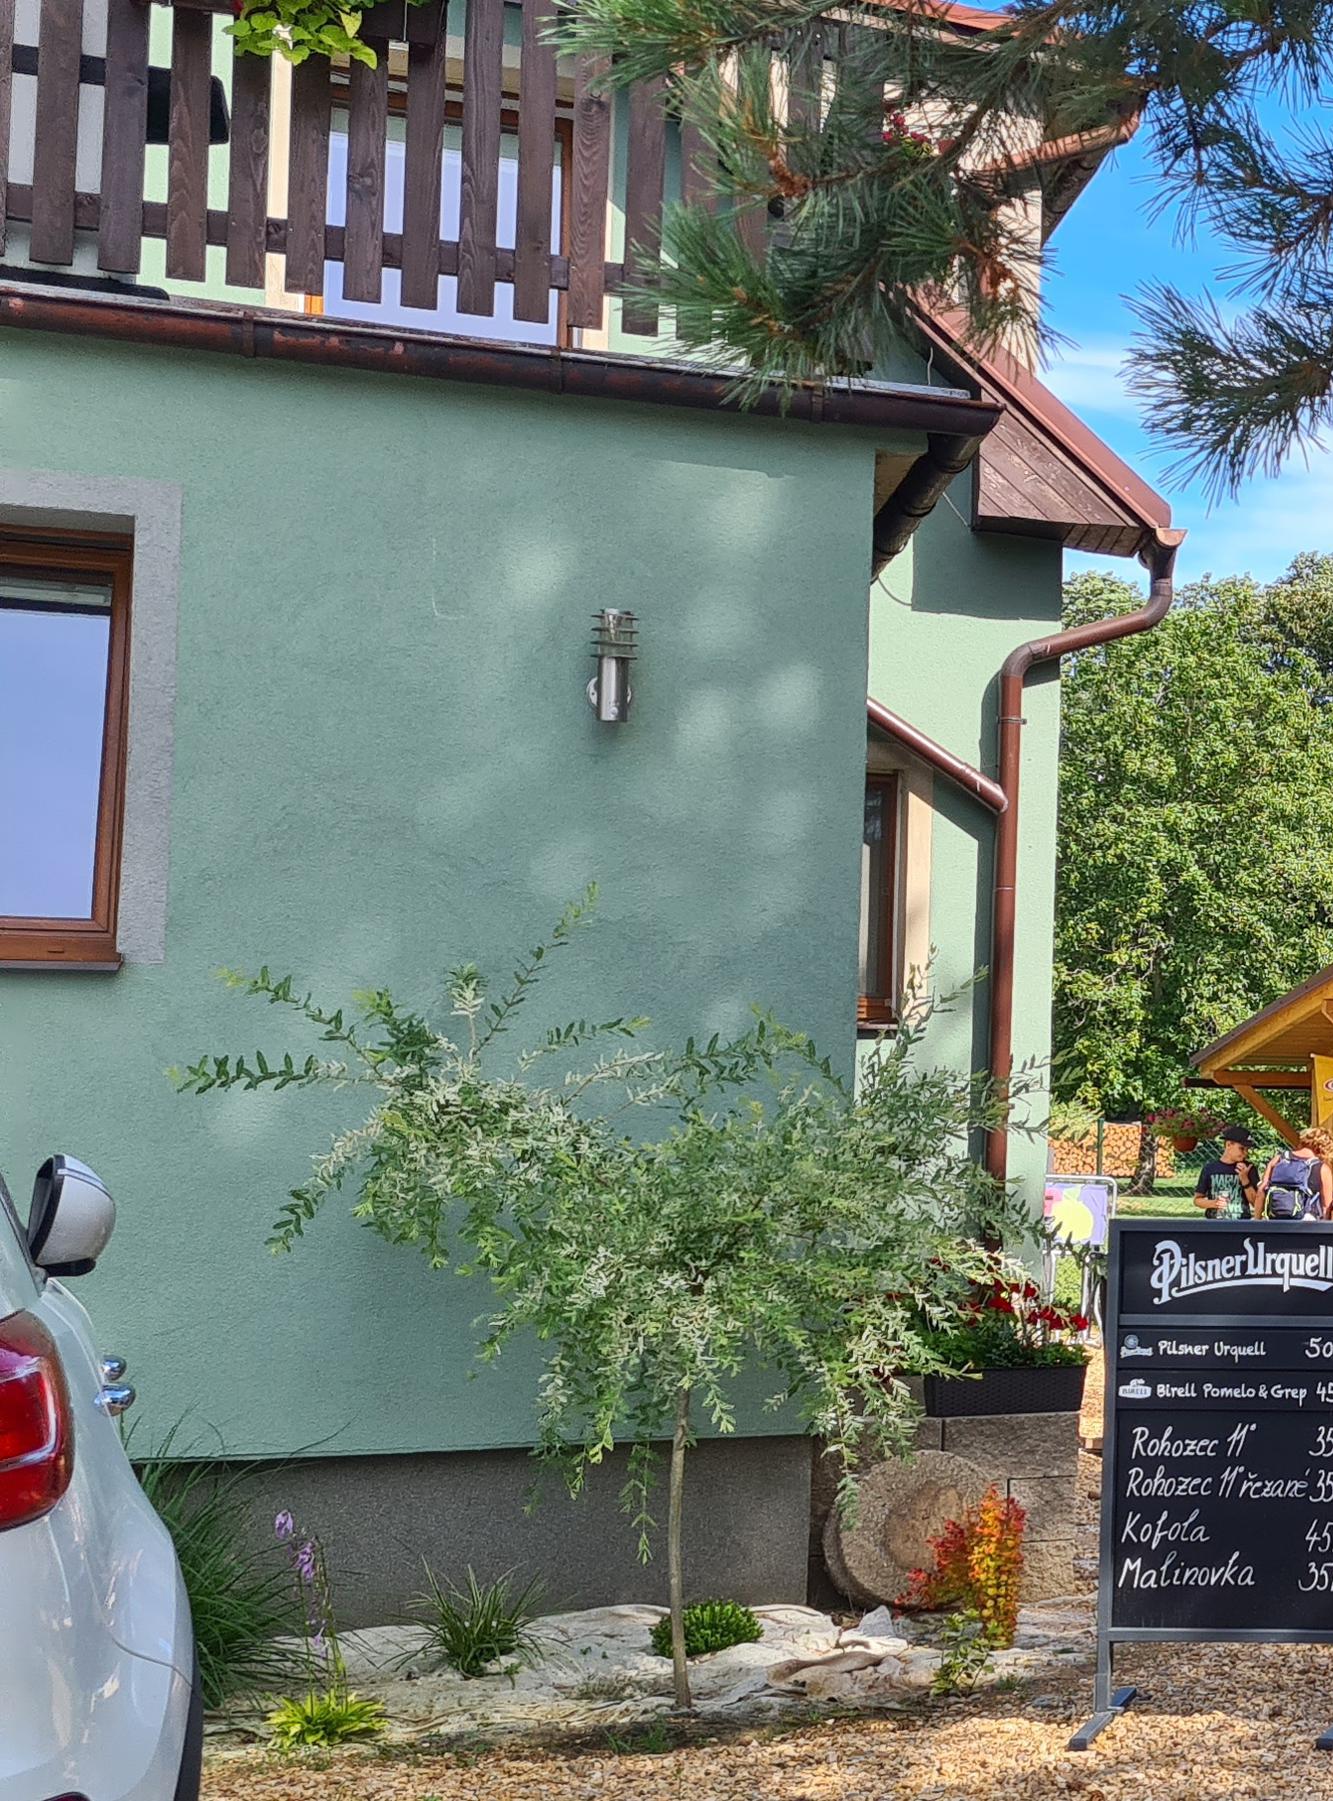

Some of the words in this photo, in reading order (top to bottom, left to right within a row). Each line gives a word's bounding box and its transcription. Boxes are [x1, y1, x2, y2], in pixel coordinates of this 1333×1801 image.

[1150, 1240, 1247, 1305] Pilsner
[1158, 1340, 1209, 1356] Pilsner
[1214, 1341, 1266, 1363] Urquell
[1304, 1337, 1333, 1358] 50
[1156, 1383, 1197, 1398] Birell
[1202, 1383, 1256, 1398] Pomelo
[1258, 1384, 1269, 1399] &
[1270, 1384, 1307, 1407] Grep
[1131, 1425, 1219, 1459] Rohozec
[1126, 1465, 1212, 1497] Rohozec
[1121, 1508, 1210, 1550] Kofola
[1118, 1550, 1255, 1589] Malinovka
